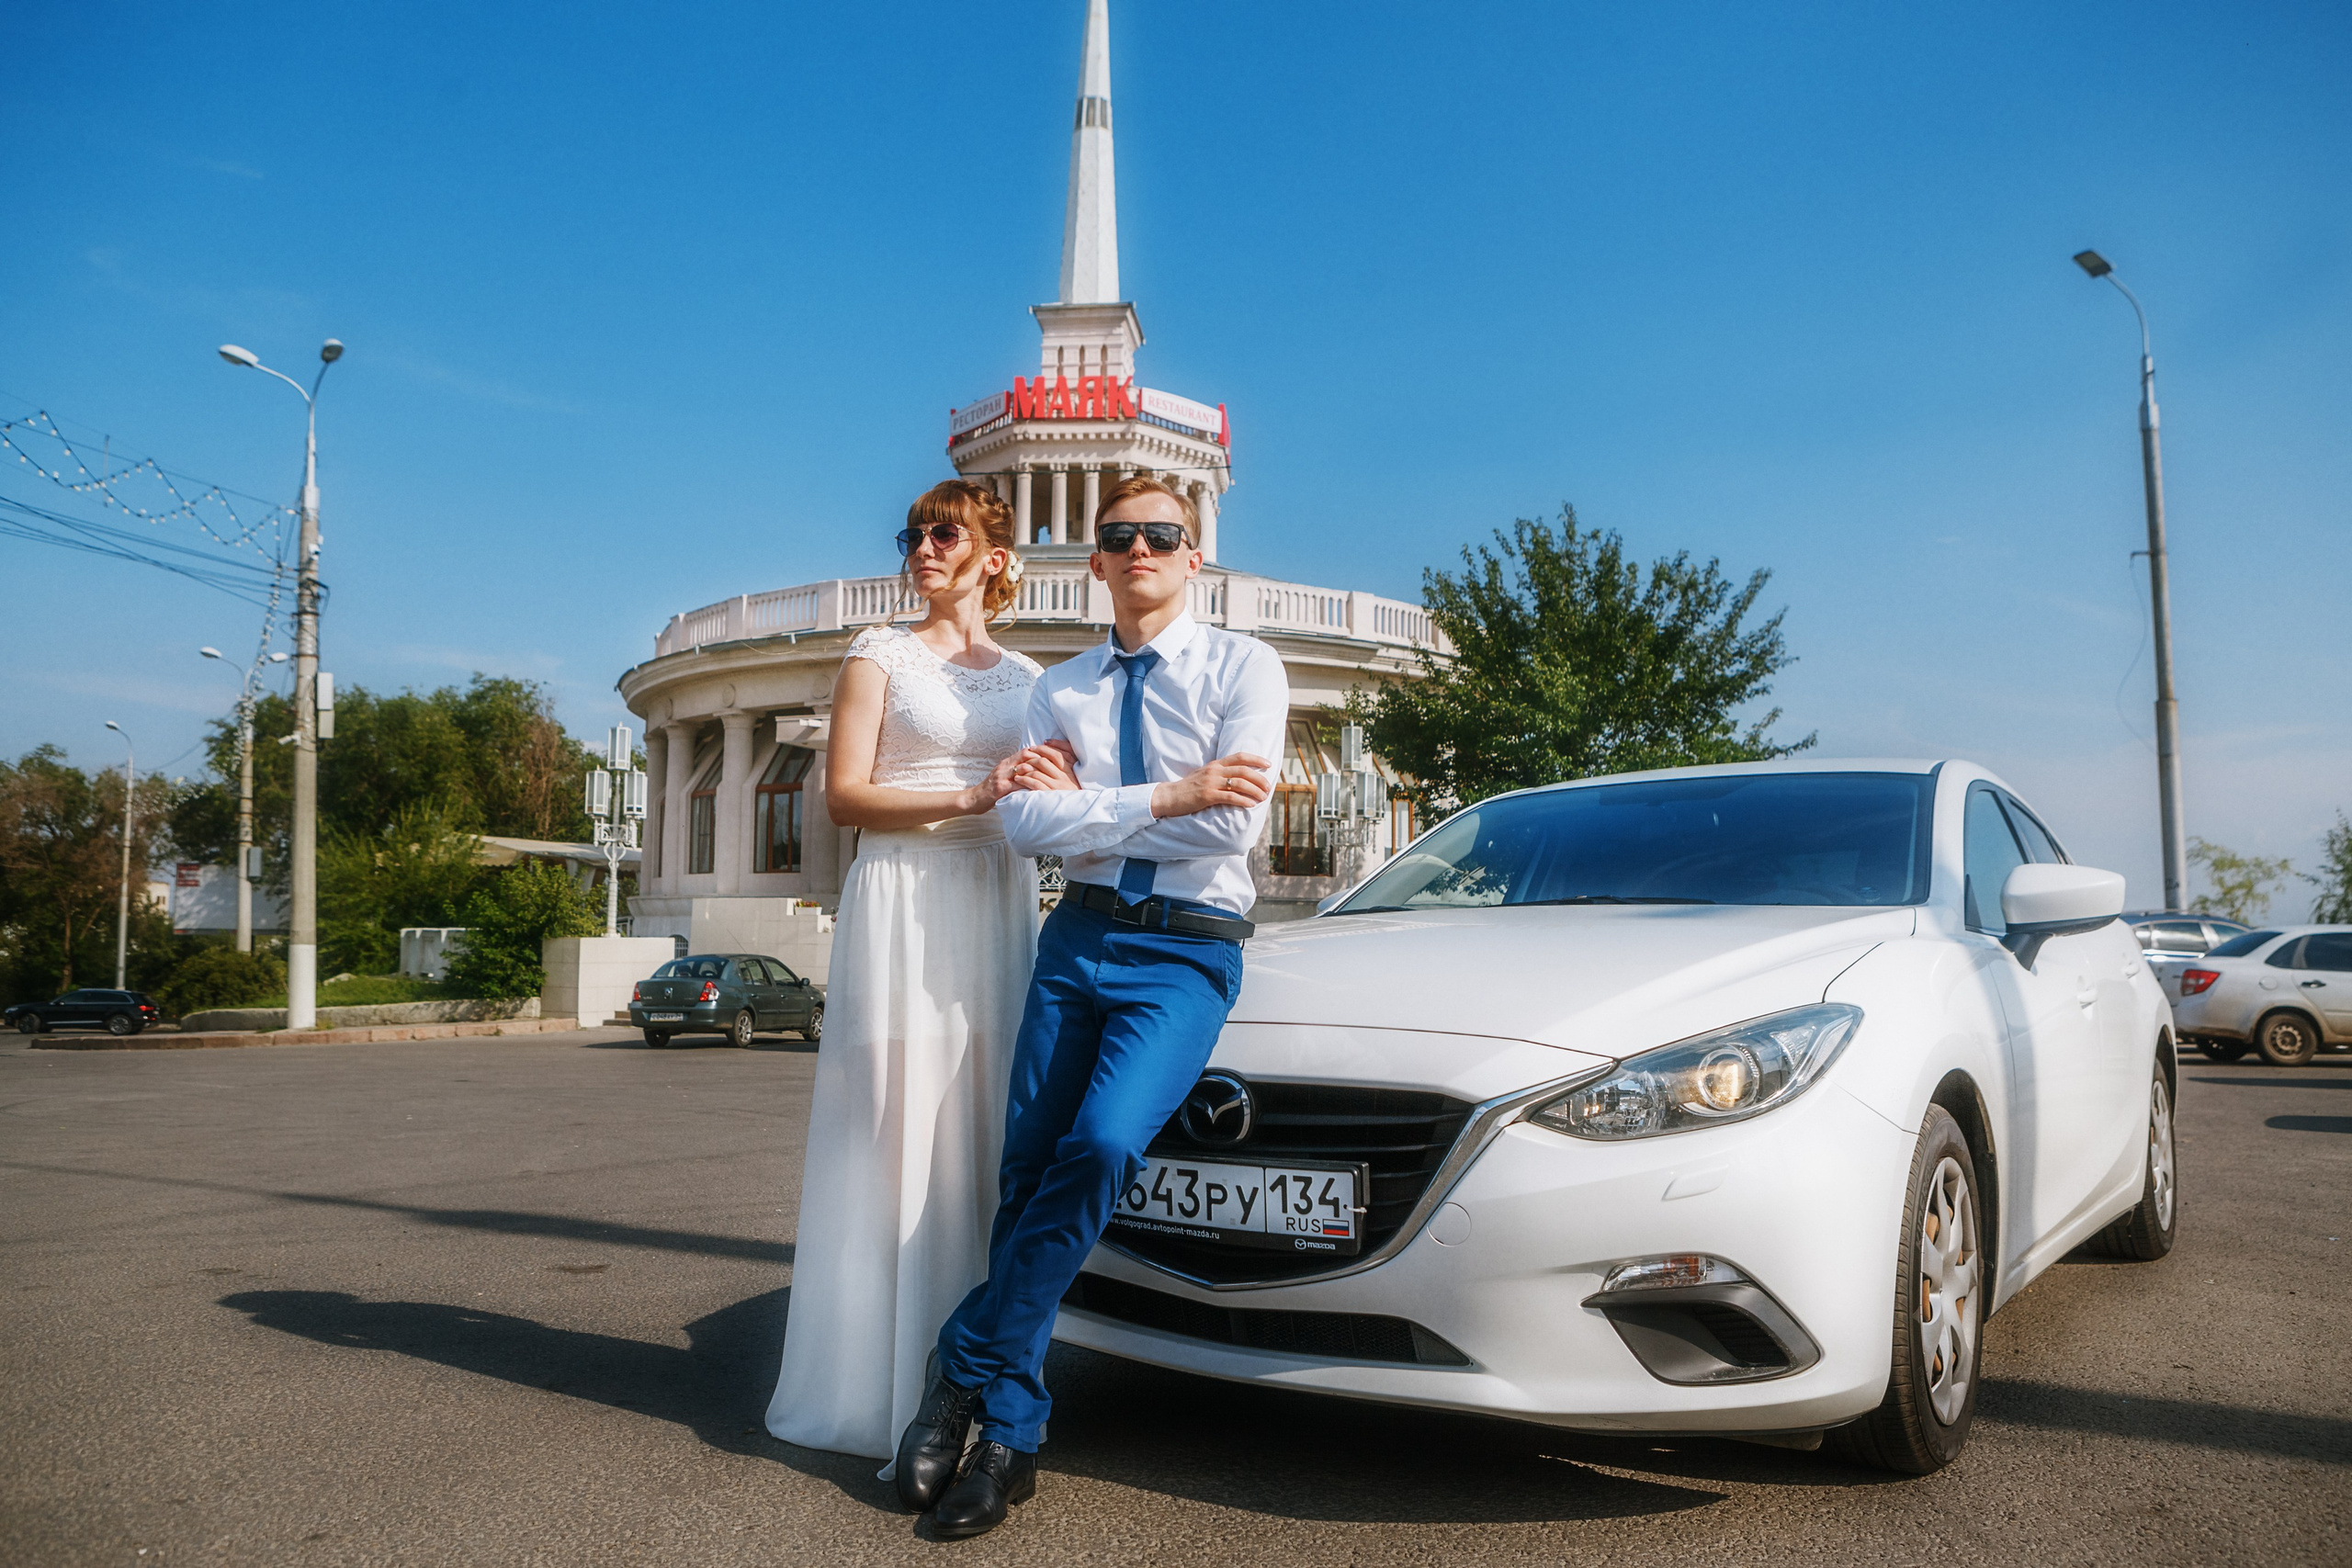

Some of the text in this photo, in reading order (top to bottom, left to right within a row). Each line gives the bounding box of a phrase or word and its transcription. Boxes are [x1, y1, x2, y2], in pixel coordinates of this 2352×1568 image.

[1013, 376, 1137, 419] МАЯК
[1148, 395, 1216, 426] RESTAURANT
[953, 397, 1001, 431] РЕСТОРАН
[1116, 1166, 1340, 1225] 643РУ 134
[1286, 1216, 1321, 1234] RUS
[1306, 1241, 1336, 1250] mazda
